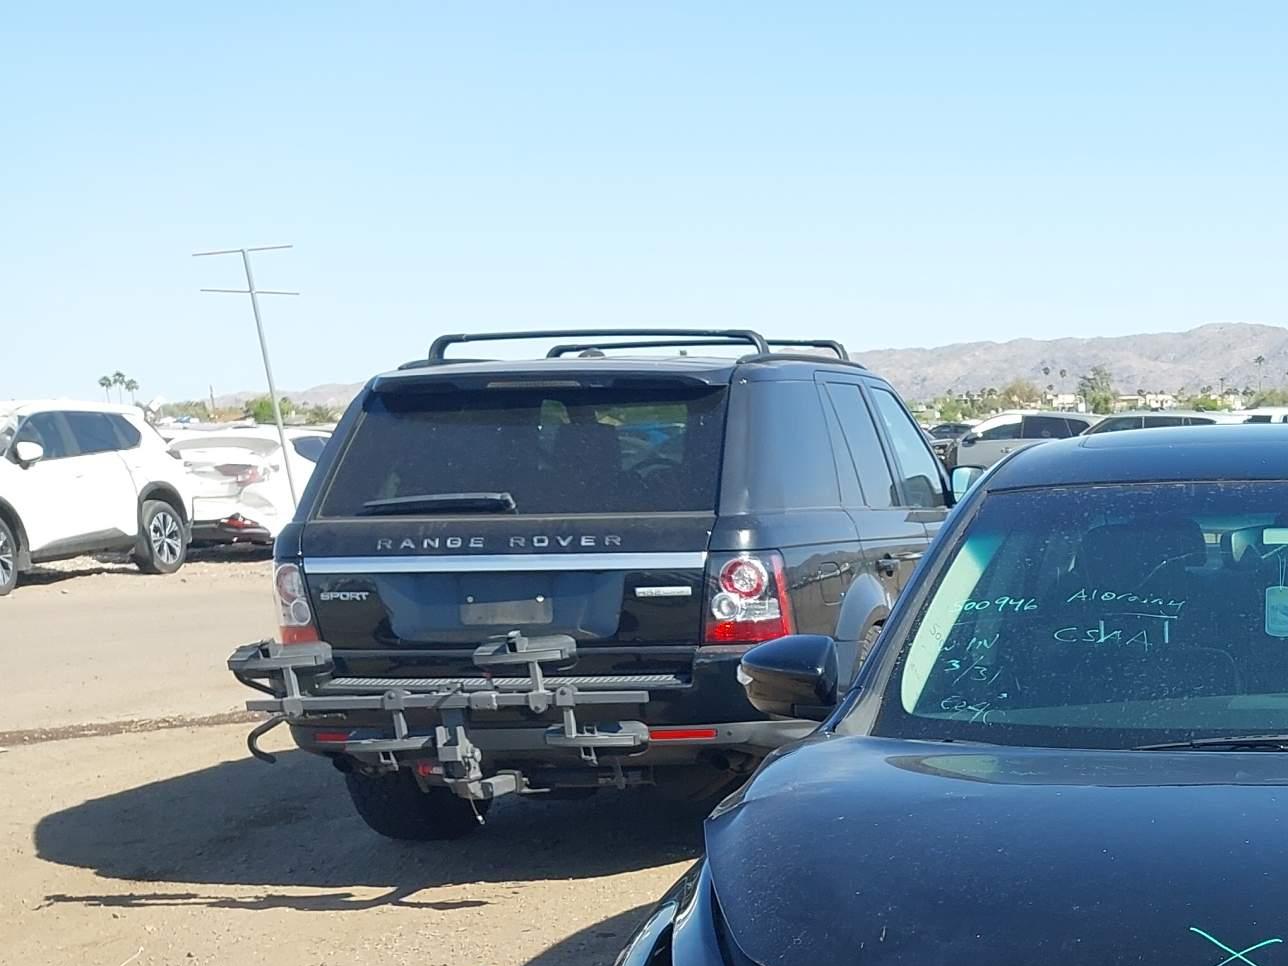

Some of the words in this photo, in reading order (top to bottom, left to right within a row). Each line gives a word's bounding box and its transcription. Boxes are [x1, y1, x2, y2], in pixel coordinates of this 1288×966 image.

[376, 537, 485, 550] RANGE
[509, 535, 622, 548] ROVER
[319, 591, 371, 601] SPORT
